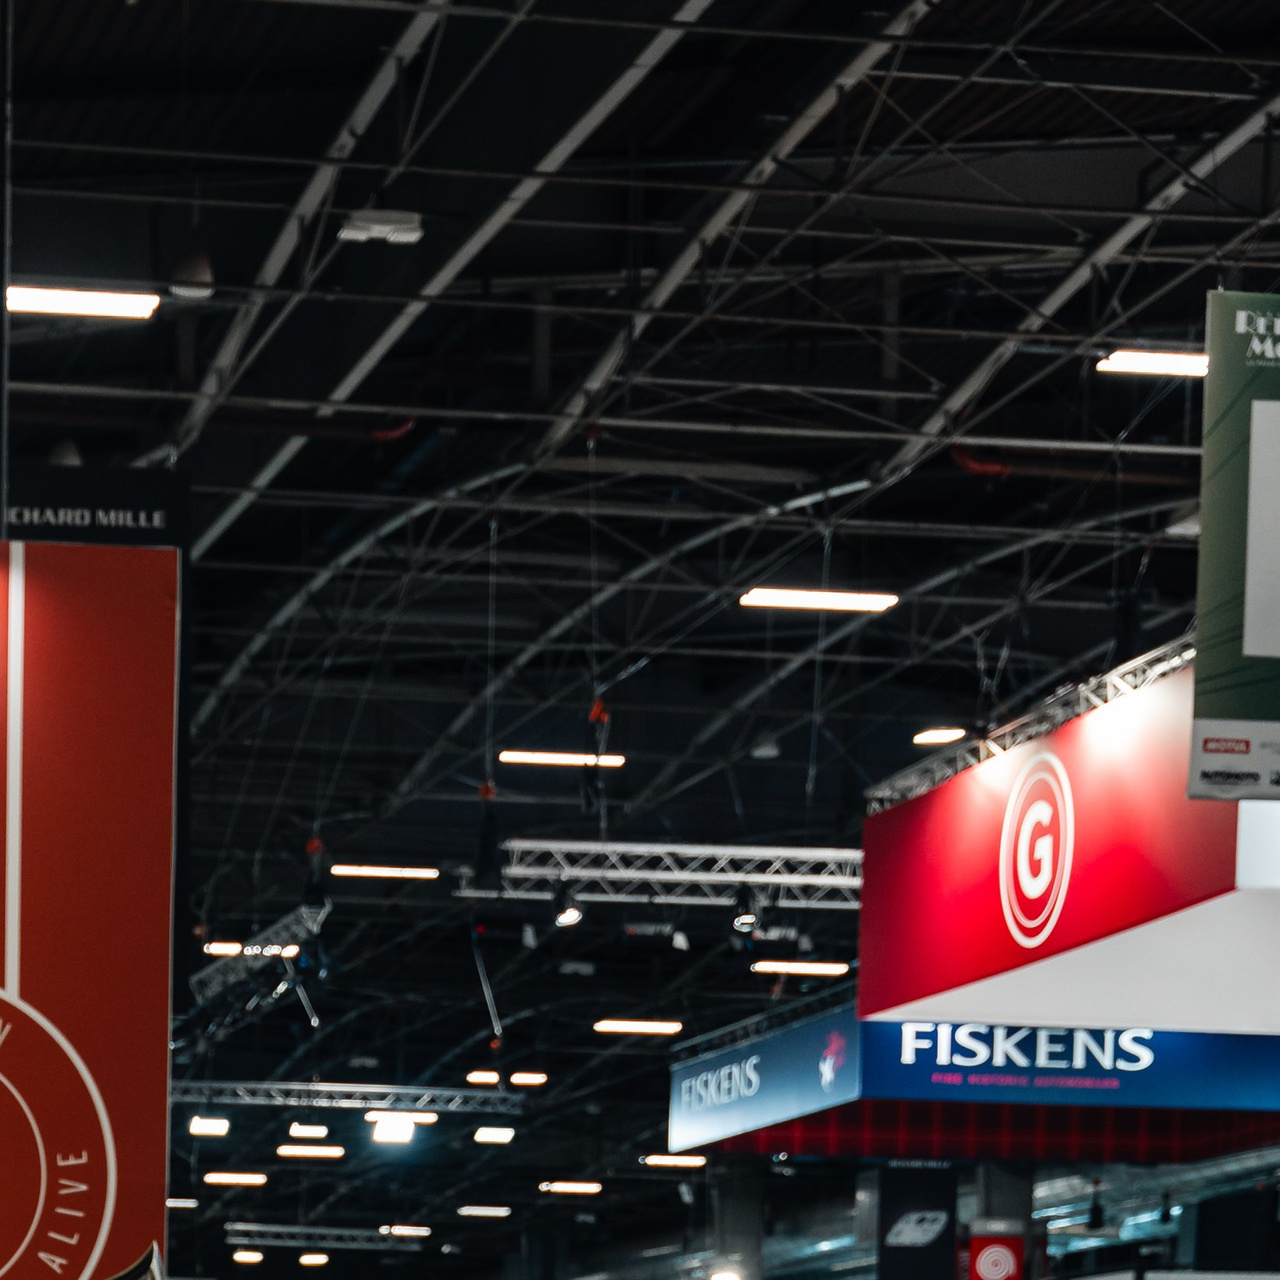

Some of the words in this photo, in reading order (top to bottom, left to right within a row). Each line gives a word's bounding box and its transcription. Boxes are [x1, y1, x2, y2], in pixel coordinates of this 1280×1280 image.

[96, 509, 166, 529] MILLE
[1017, 799, 1054, 900] G
[899, 1022, 1155, 1072] FISKENS
[681, 1055, 761, 1112] FISKENS
[38, 1150, 88, 1275] ALIVE
